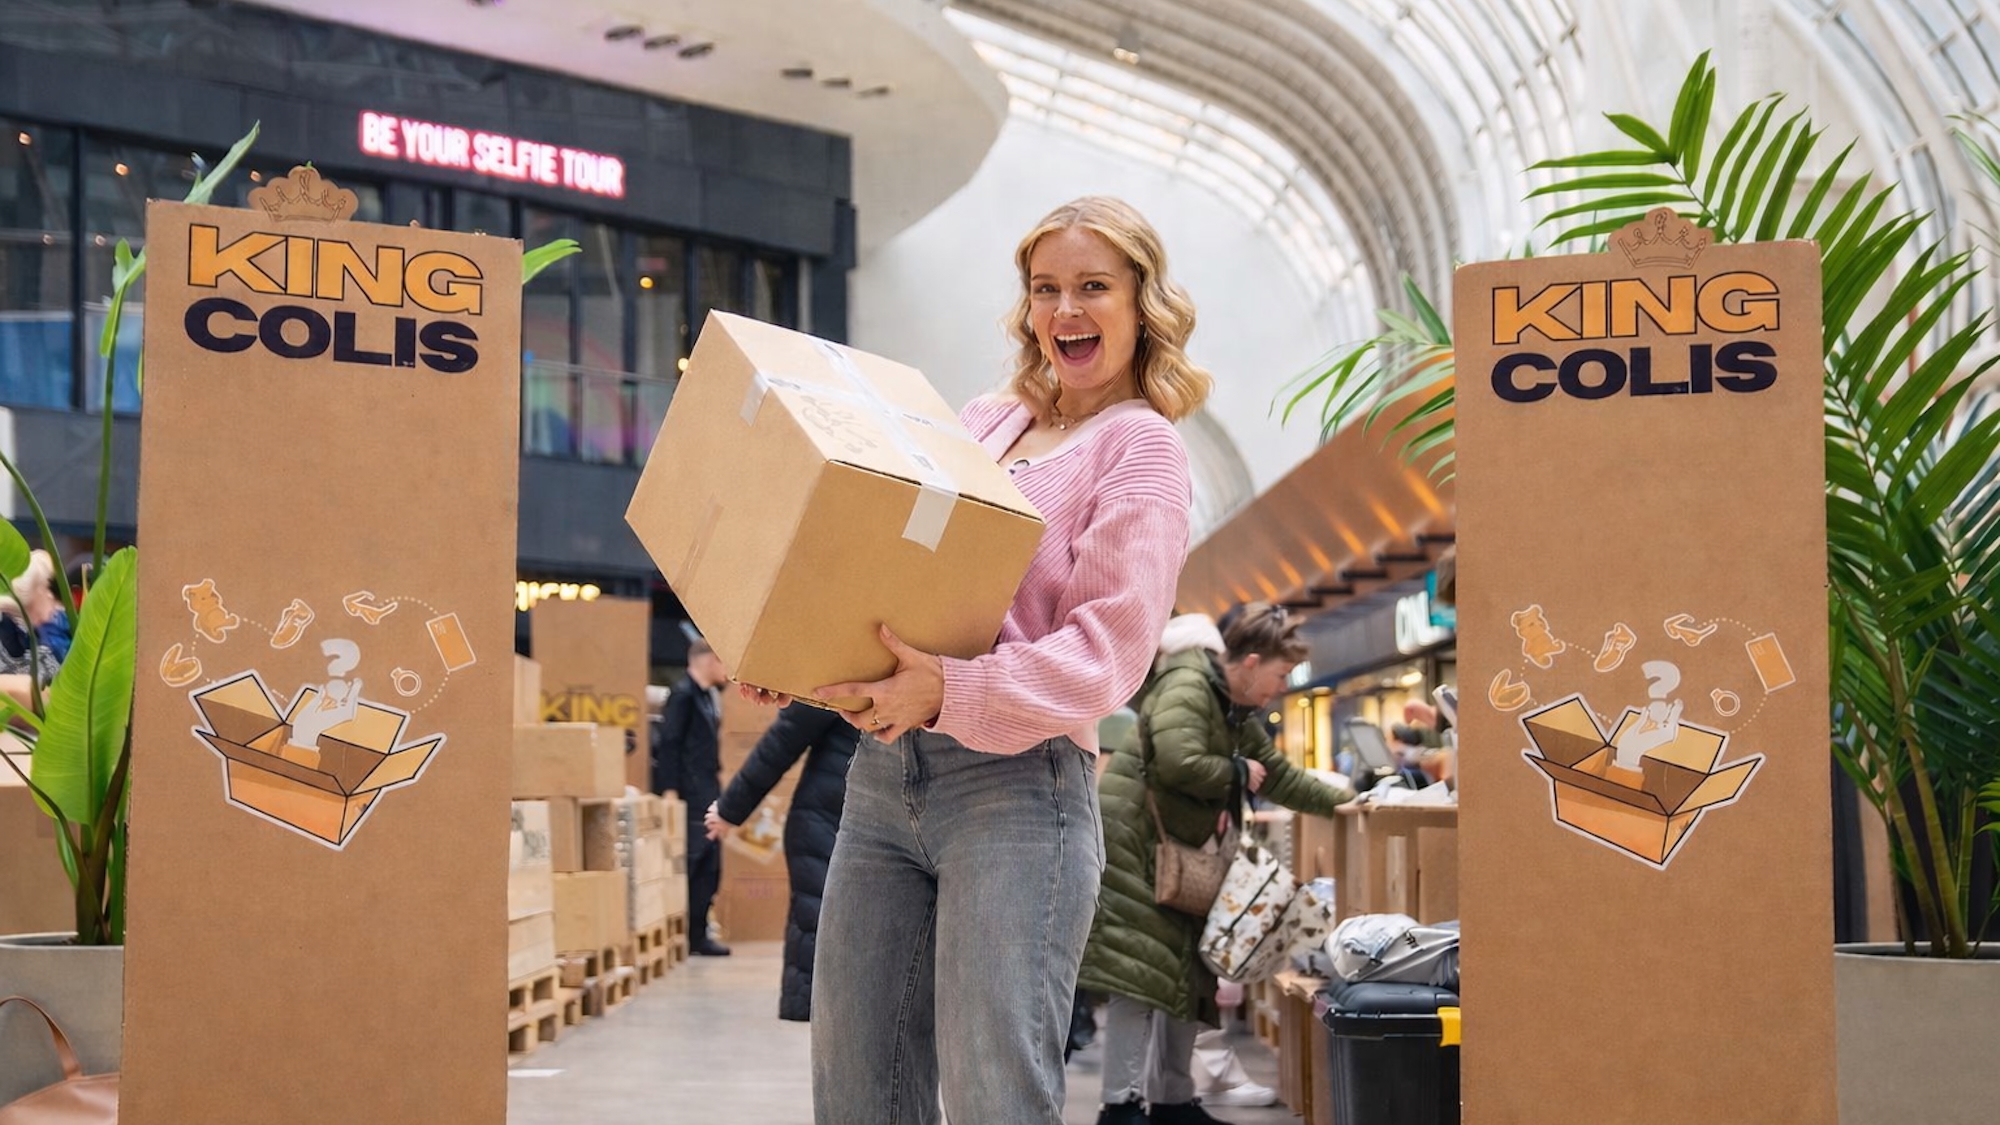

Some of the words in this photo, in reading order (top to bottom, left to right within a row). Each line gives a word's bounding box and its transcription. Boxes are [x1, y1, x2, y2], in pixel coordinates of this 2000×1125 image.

[360, 111, 399, 157] BE
[400, 119, 470, 168] YOUR
[472, 132, 558, 185] SELFIE
[560, 148, 624, 197] TOUR
[188, 223, 483, 316] KING
[184, 297, 479, 373] COLIS
[1492, 271, 1780, 345] KING
[1491, 341, 1777, 404] COLIS
[539, 691, 640, 728] KING
